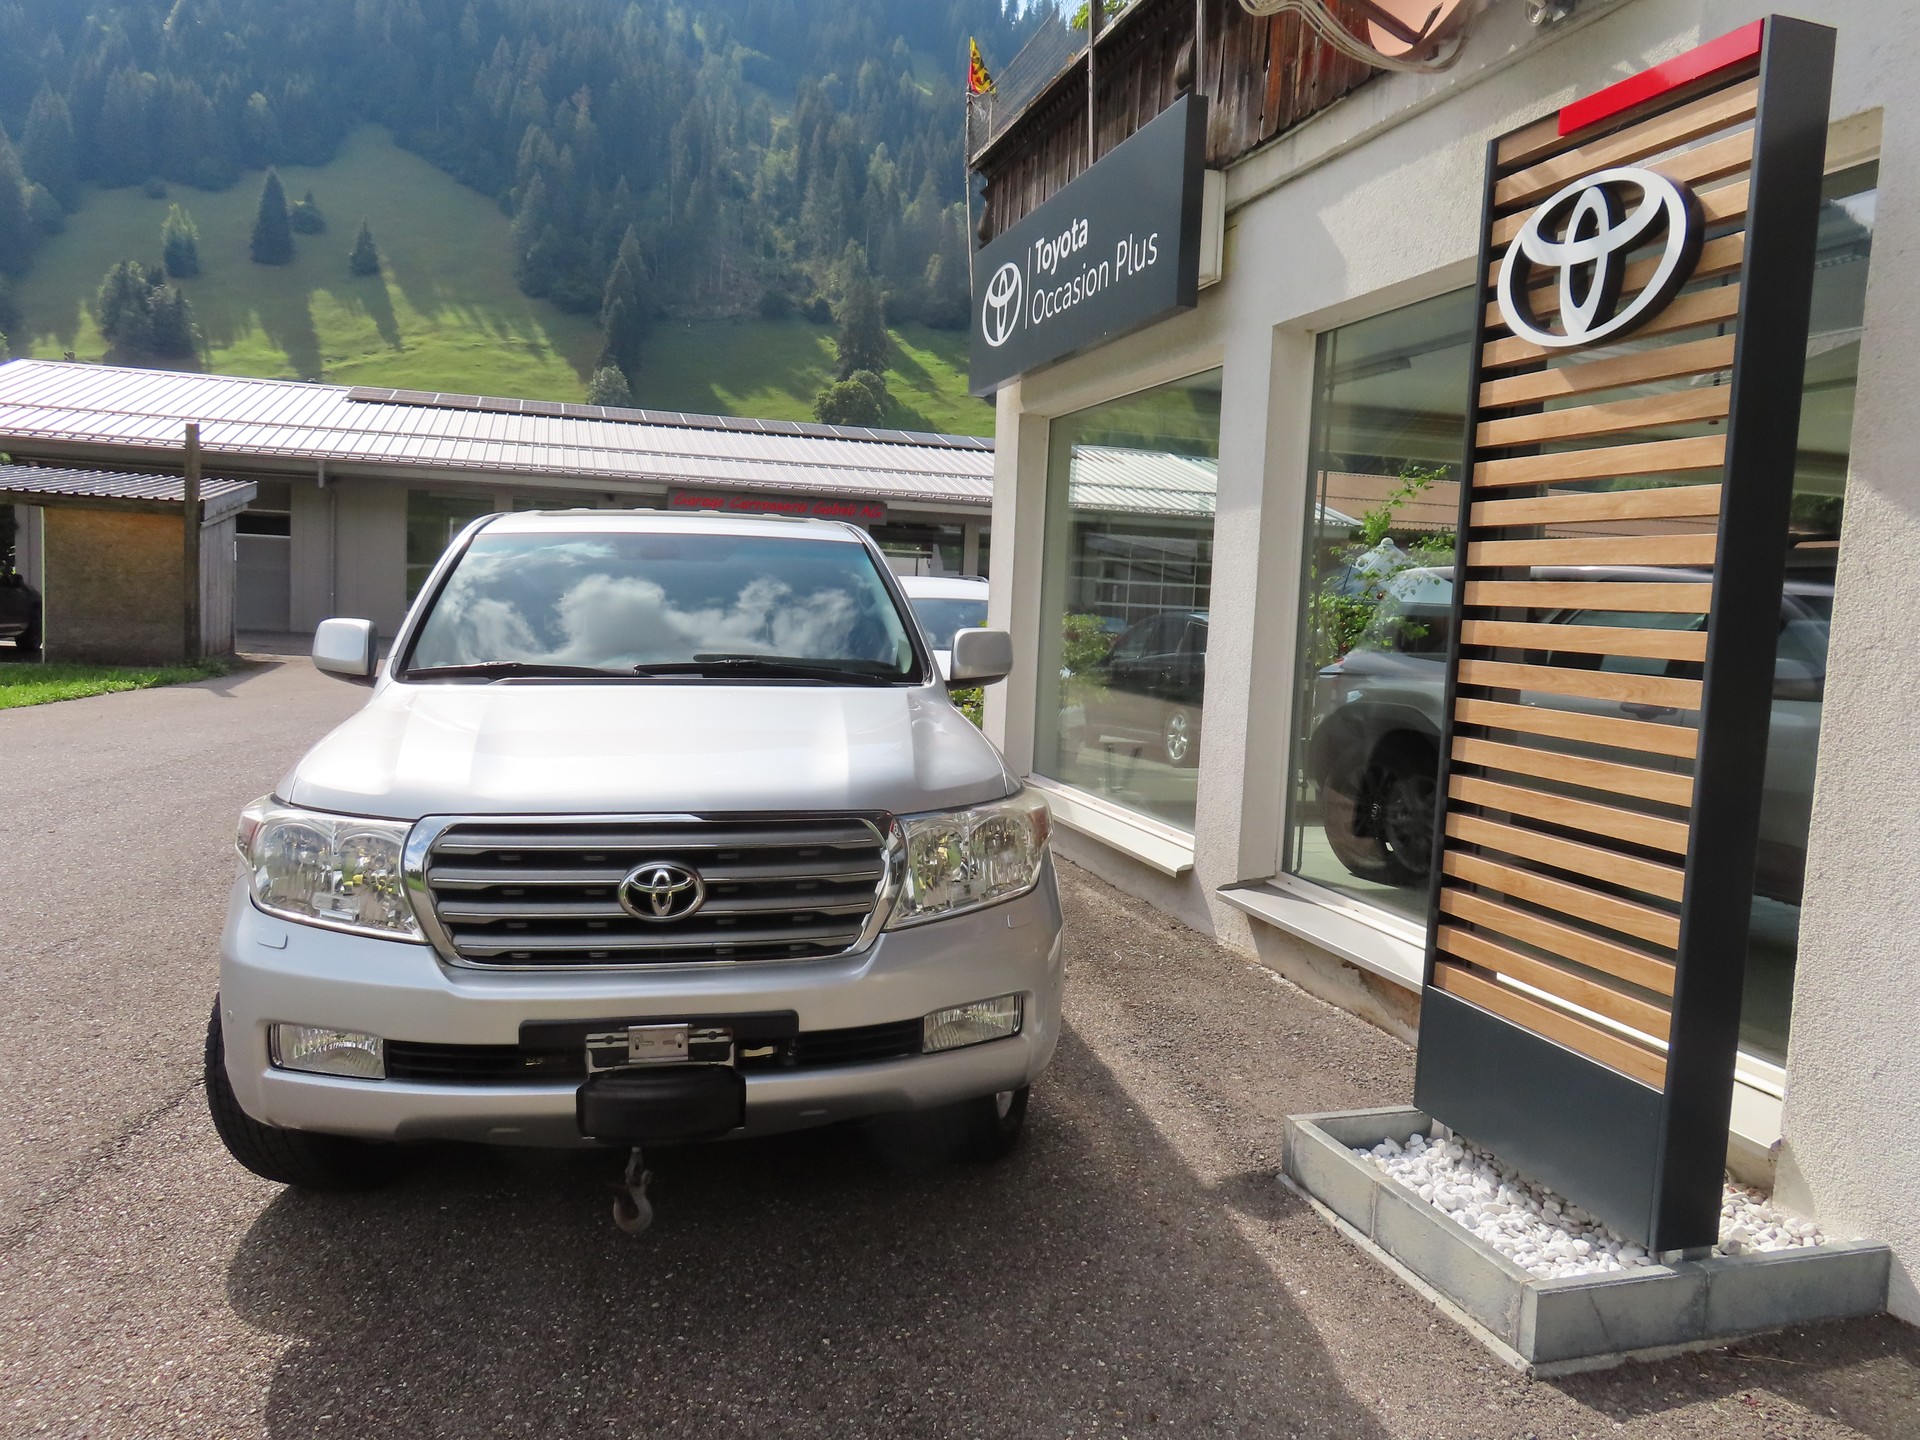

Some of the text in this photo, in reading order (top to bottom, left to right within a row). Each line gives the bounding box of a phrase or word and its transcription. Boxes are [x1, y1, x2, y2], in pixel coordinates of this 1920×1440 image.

[1035, 218, 1089, 275] Toyota
[1032, 232, 1158, 325] Occasion Plus
[673, 492, 724, 512] Garage
[860, 504, 883, 519] AG
